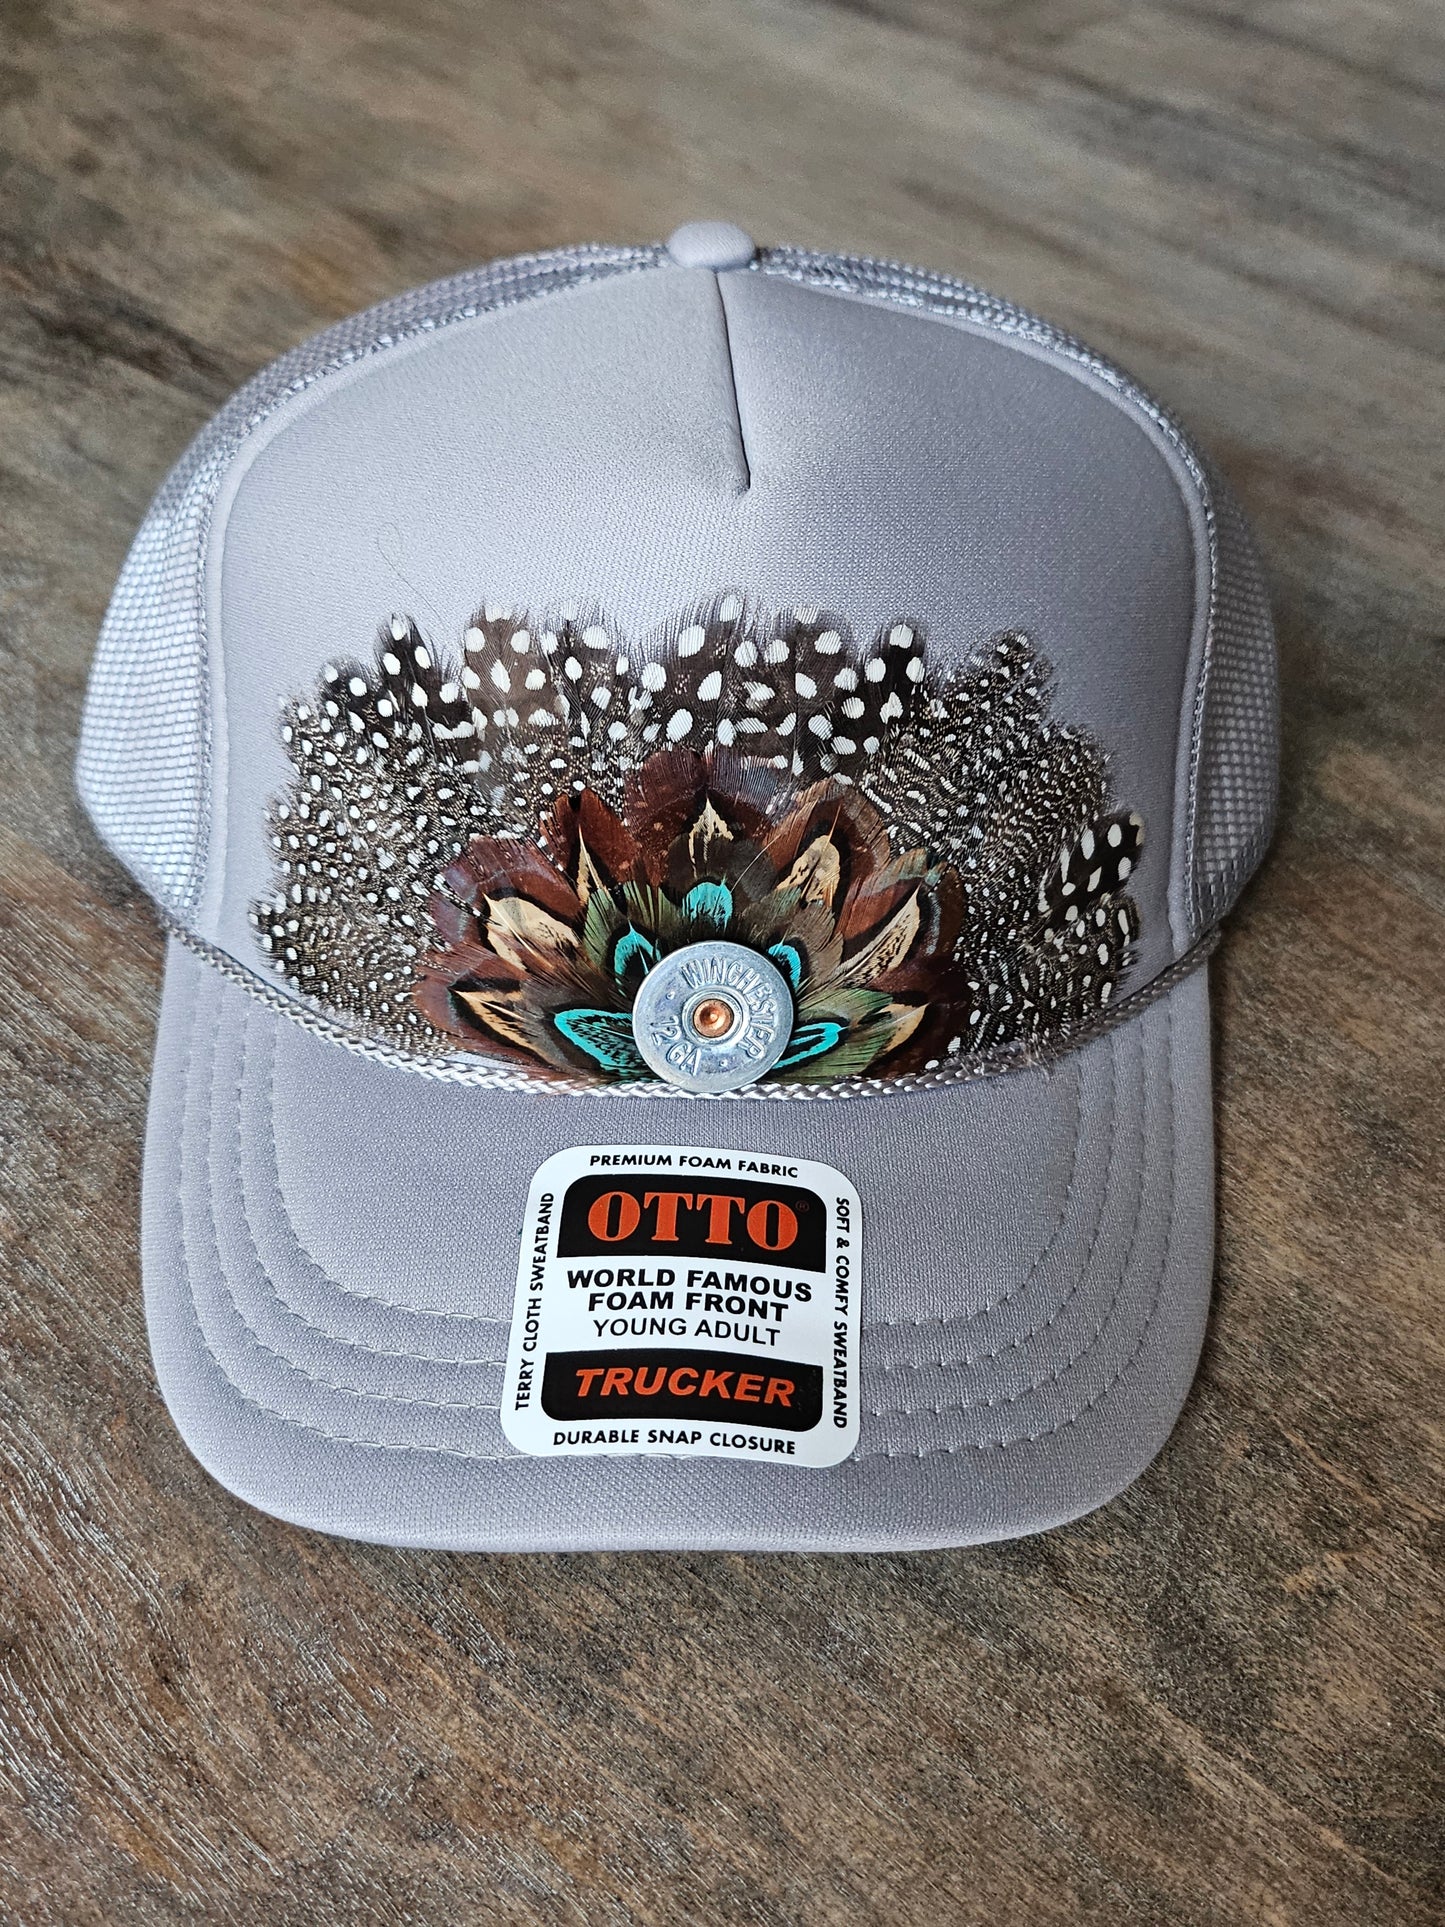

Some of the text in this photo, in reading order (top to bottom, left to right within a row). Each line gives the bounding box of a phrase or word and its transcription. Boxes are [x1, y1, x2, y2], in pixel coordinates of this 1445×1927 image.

[681, 957, 777, 1059] WINCHESTER
[651, 1016, 702, 1076] 12 GA
[590, 1155, 798, 1178] PREMIUM FOAM FABRIC
[588, 1191, 798, 1251] OTTO
[515, 1192, 554, 1410] TERRY CLOTH SWEATBAND
[567, 1269, 812, 1302] WORLD FAMOUS
[588, 1292, 788, 1322] FOAM FRONT
[833, 1197, 850, 1429] SOFT & COMFY SWEATBAND
[593, 1318, 780, 1346] YOUNG ADULT
[575, 1367, 795, 1407] TRUCKER
[553, 1429, 795, 1454] DURABLE SNAP CLOSURE
